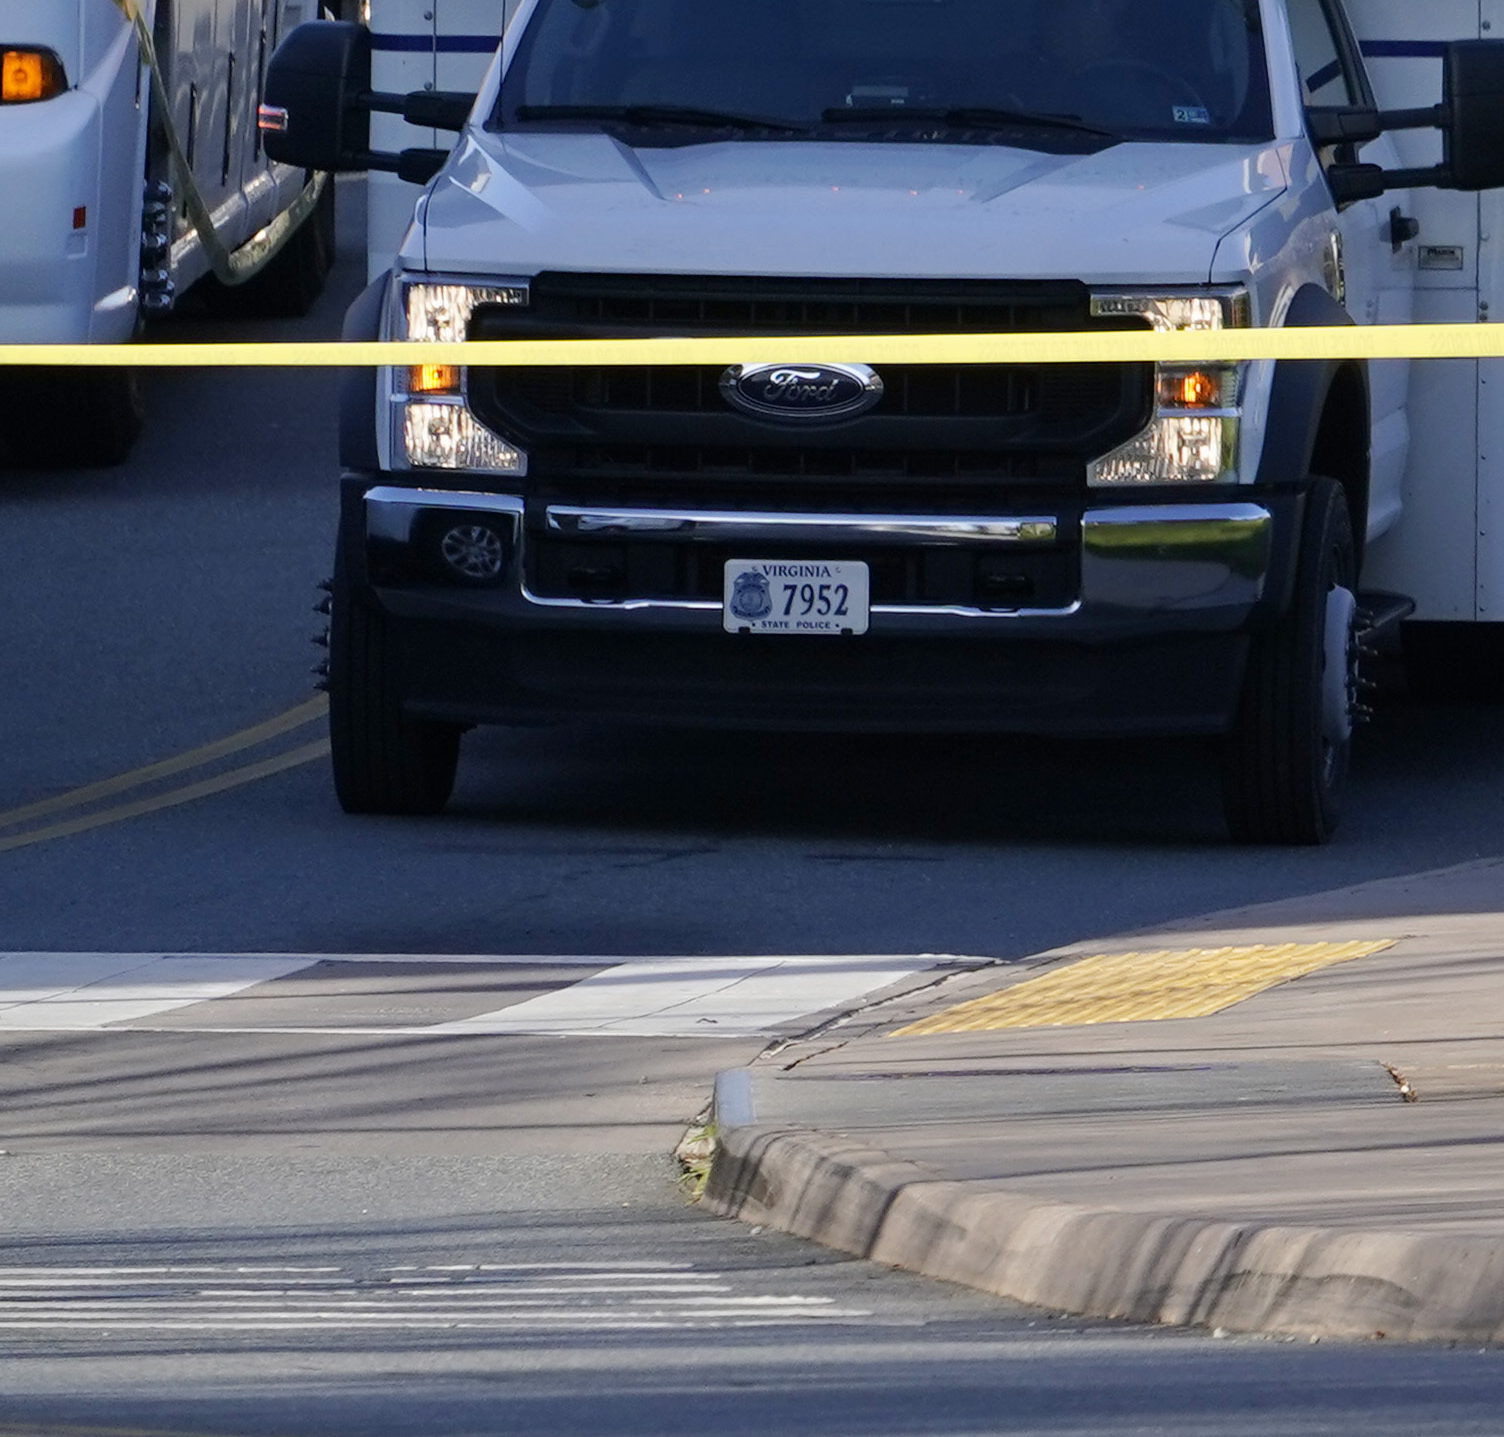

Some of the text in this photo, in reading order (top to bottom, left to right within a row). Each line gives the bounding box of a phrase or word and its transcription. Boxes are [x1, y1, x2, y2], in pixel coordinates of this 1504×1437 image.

[763, 369, 839, 402] Ford
[763, 564, 832, 578] VIRGINIA
[783, 583, 849, 617] 7952
[761, 620, 831, 630] STATE POLICE
